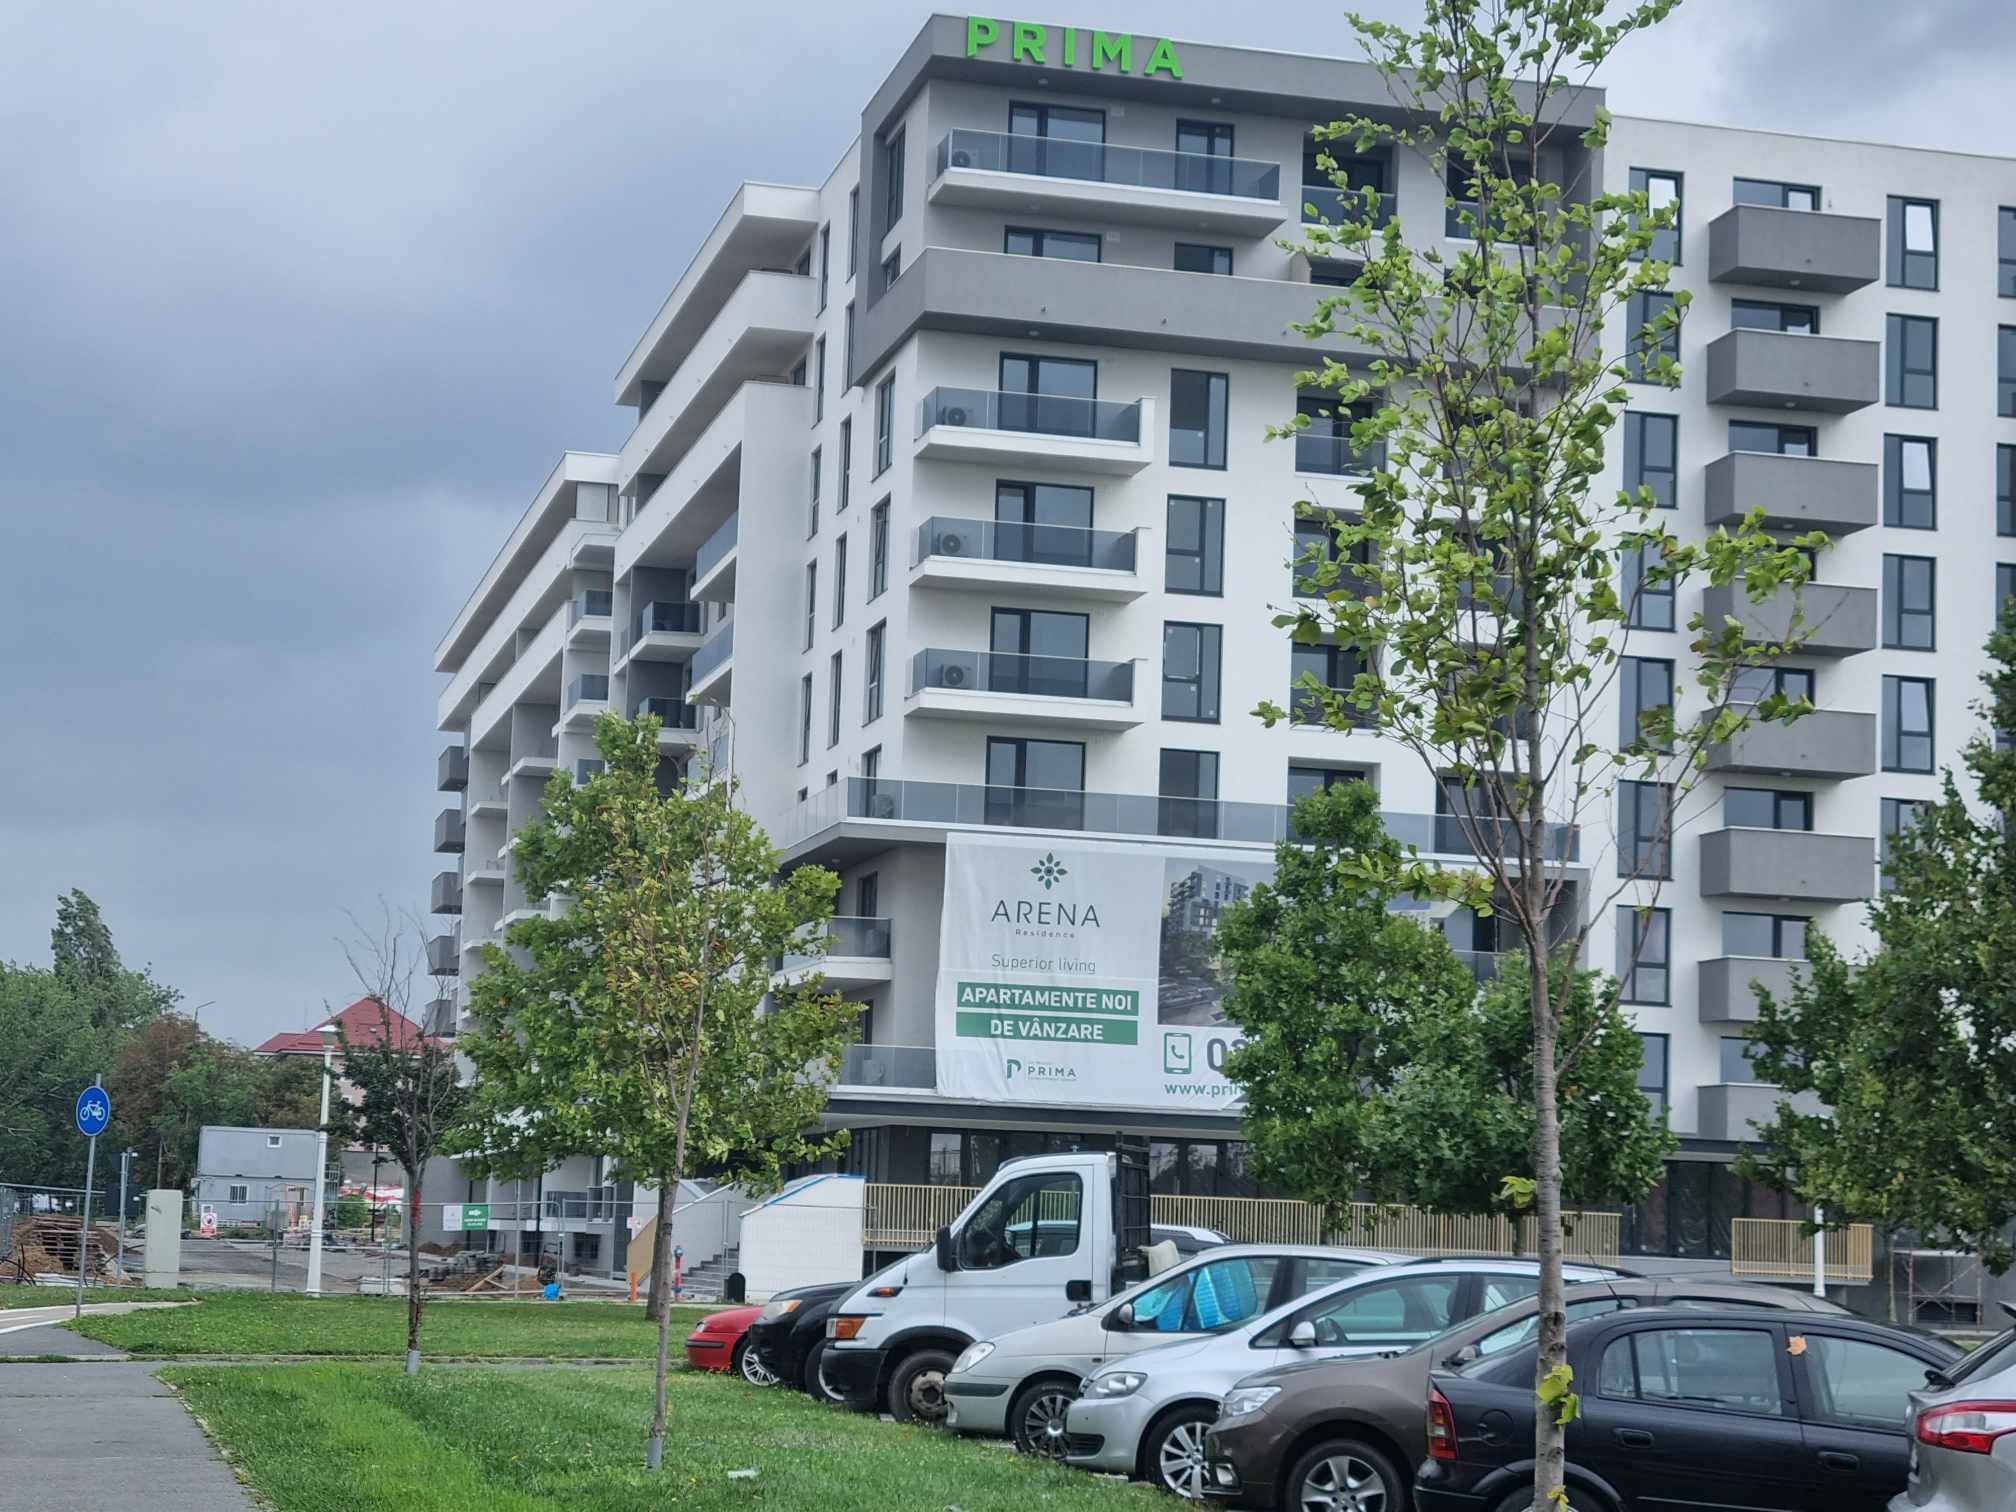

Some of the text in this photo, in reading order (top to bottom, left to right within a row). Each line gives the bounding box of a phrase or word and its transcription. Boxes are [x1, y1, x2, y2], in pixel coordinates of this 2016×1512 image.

[966, 15, 1184, 81] PRIMA
[991, 899, 1100, 928] ARENA
[1015, 928, 1075, 939] Residence
[991, 953, 1096, 975] Superior living
[961, 987, 1132, 1011] APARTAMENTE NOI
[990, 1017, 1104, 1041] DE VÂNZARE
[1027, 1065, 1077, 1078] PRIMA
